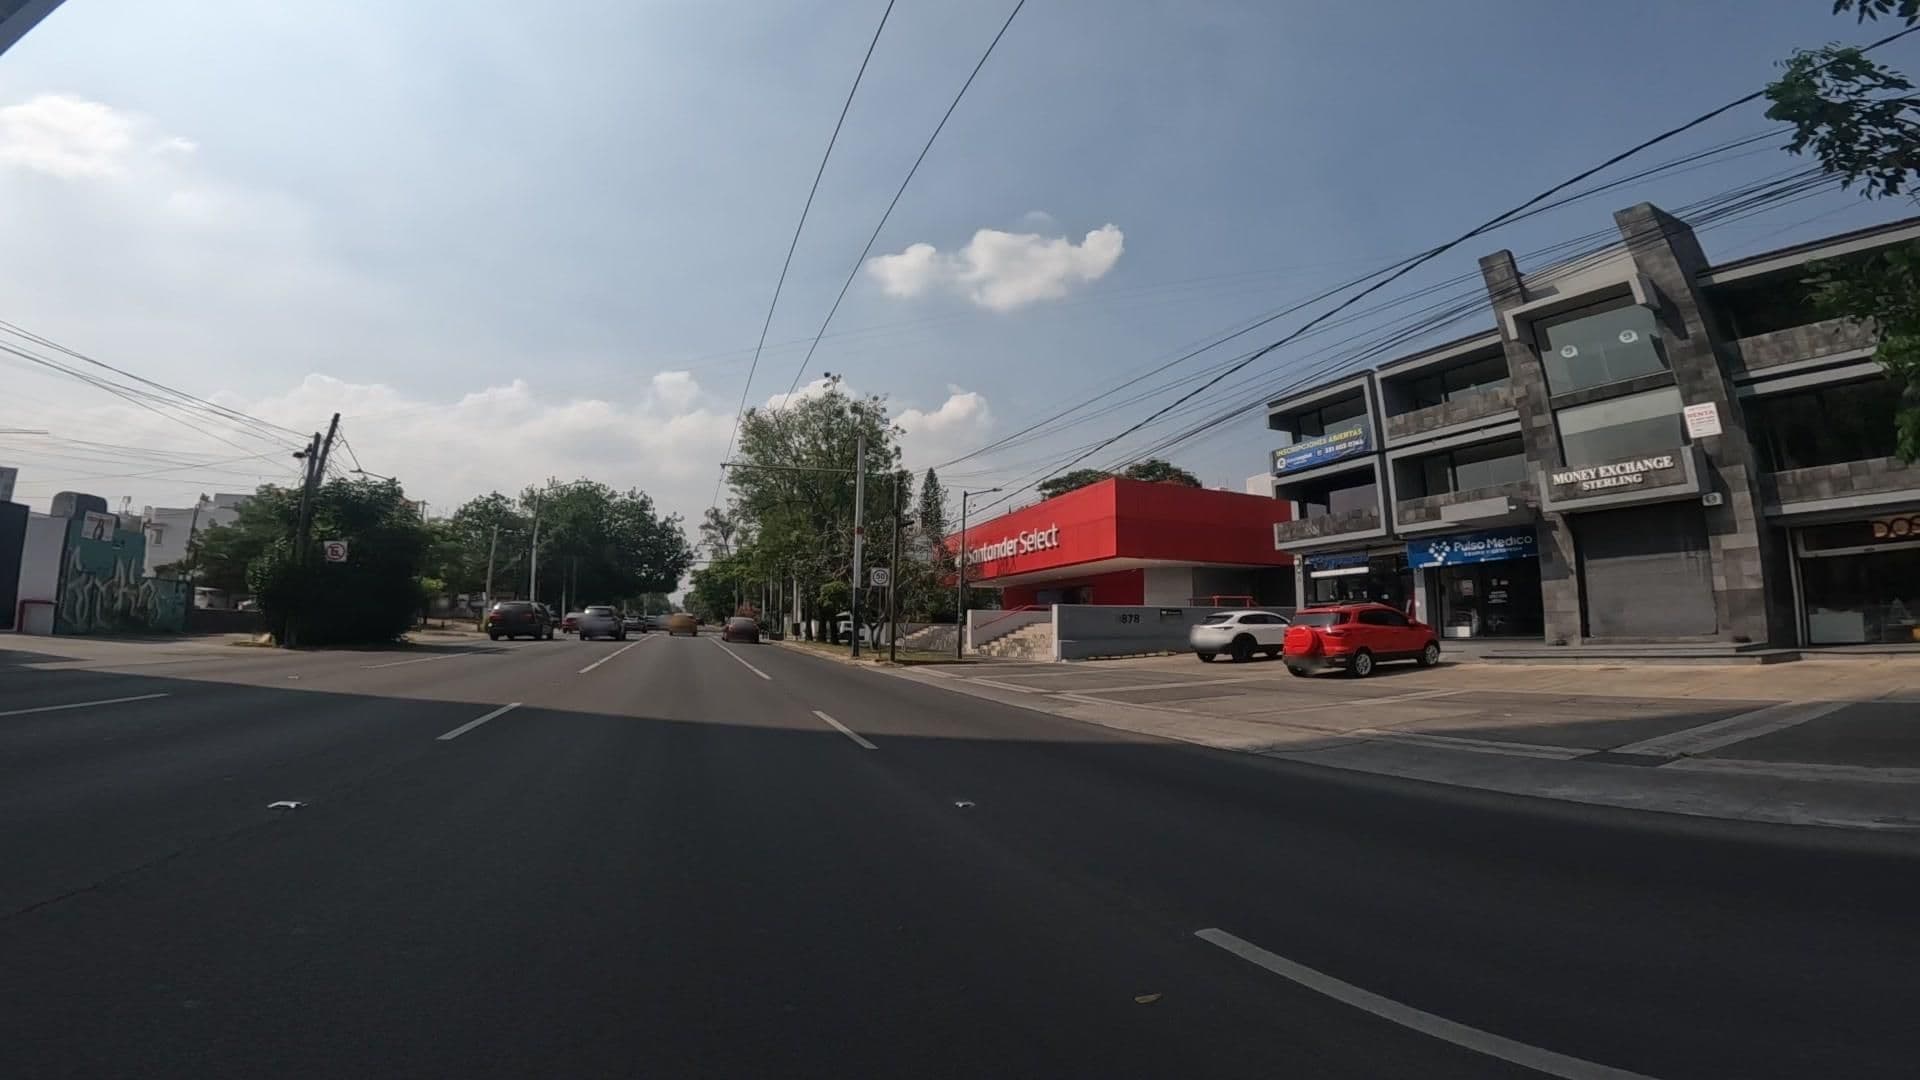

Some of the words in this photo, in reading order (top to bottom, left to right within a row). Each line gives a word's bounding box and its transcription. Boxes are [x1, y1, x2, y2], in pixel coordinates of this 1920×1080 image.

[1552, 467, 1597, 485] MONEY
[1599, 455, 1674, 478] EXCHANGE
[1582, 473, 1644, 491] STERLING
[968, 536, 1019, 565] Santander
[1019, 523, 1059, 554] Select
[1453, 540, 1485, 552] Pulso
